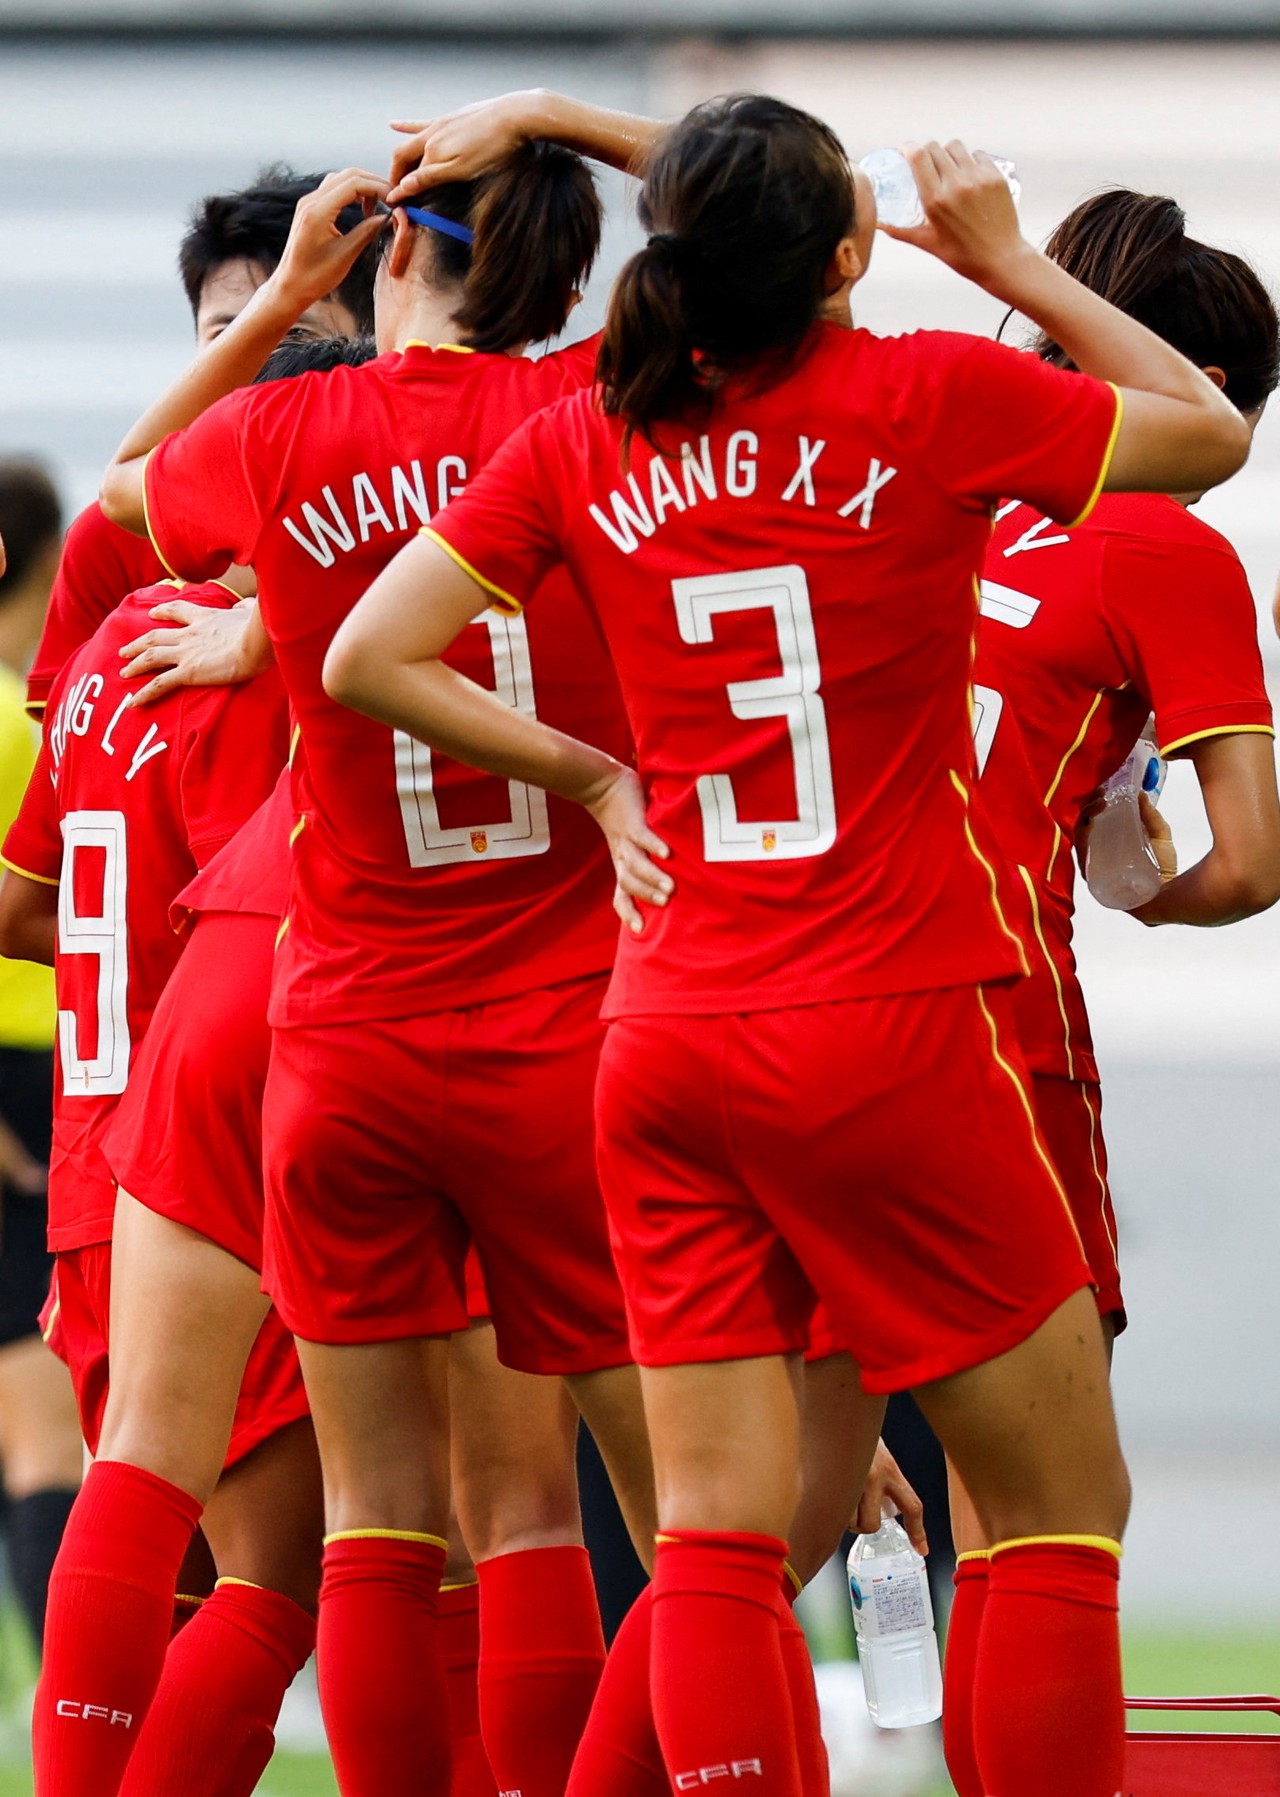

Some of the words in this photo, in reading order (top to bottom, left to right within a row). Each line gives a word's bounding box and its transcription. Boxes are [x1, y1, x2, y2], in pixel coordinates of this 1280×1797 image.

[281, 454, 468, 570] WANG
[588, 429, 759, 555] WANG
[780, 434, 826, 507] X
[836, 457, 898, 531] X
[124, 721, 169, 782] Y
[671, 563, 837, 863] 3
[56, 1699, 133, 1729] CFA
[675, 1757, 763, 1791] CFA
